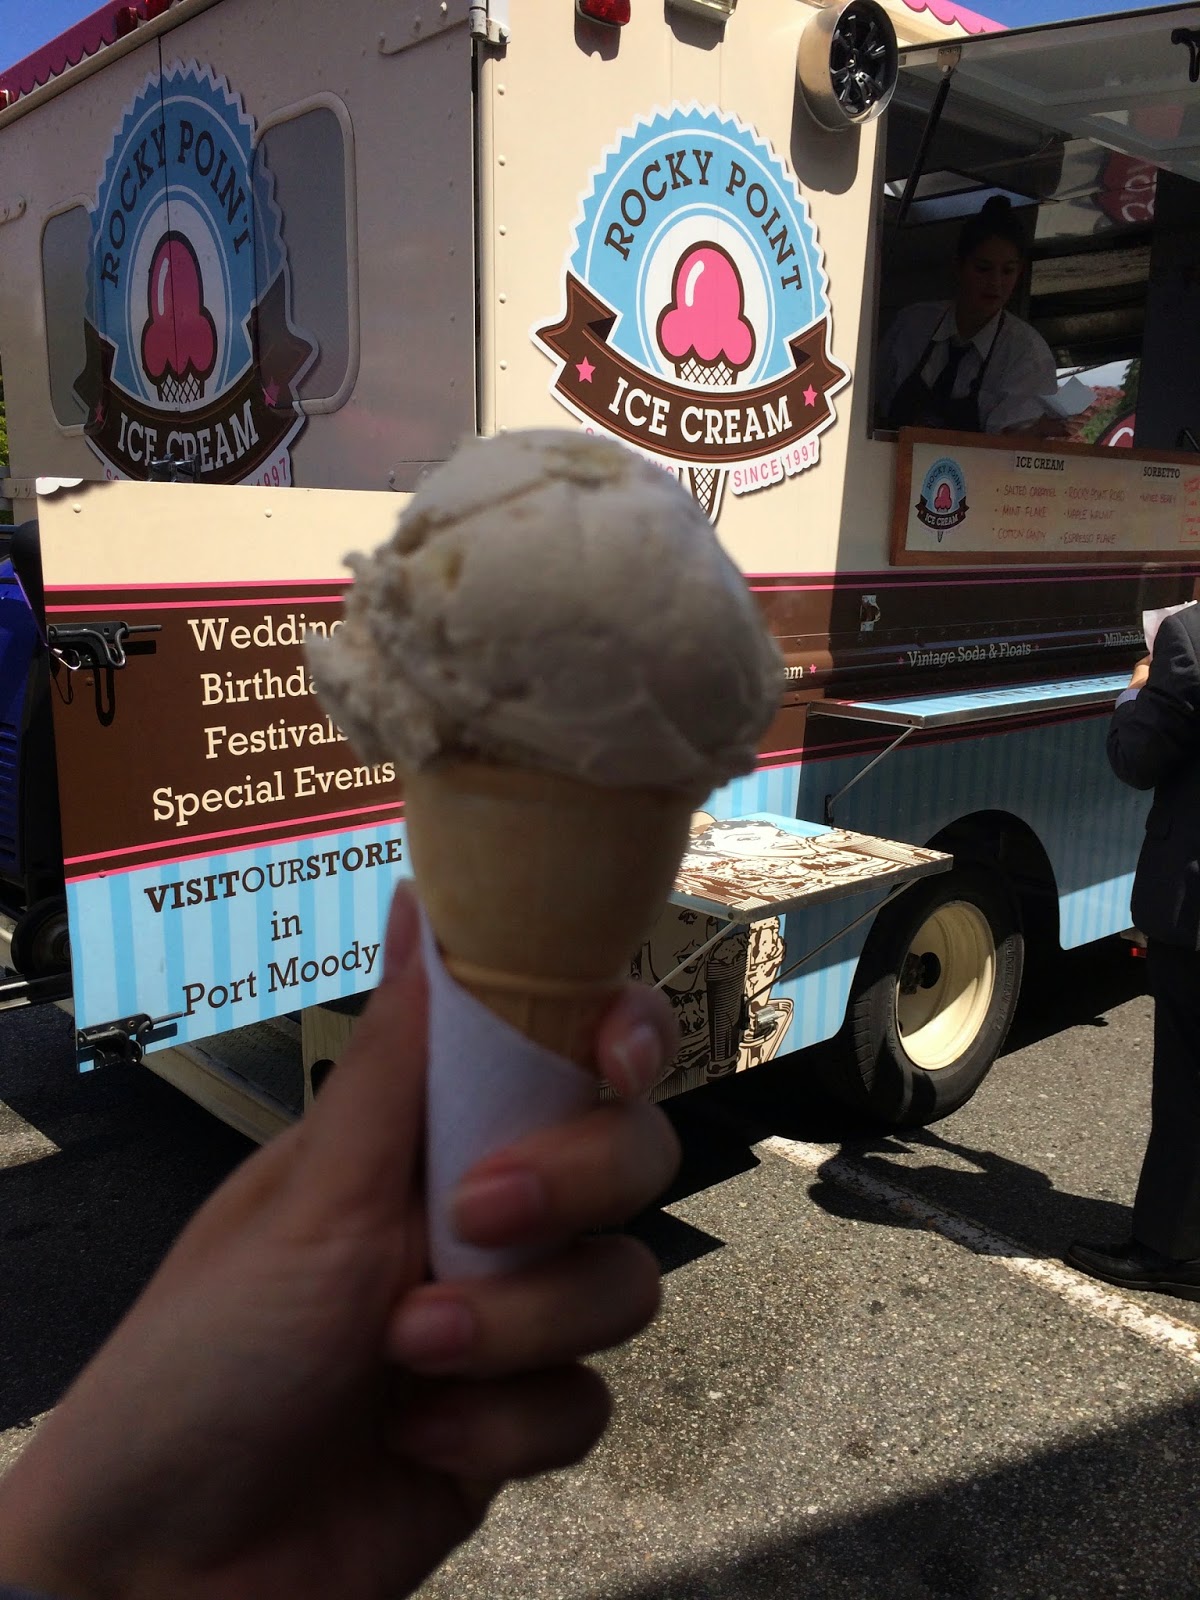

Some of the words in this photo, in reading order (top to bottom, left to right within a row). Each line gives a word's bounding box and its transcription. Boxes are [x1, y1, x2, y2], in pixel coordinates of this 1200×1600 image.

[101, 122, 166, 288] ROCKY
[178, 120, 252, 255] POINT
[603, 149, 714, 262] ROCKY
[725, 161, 804, 291] POINT
[607, 376, 671, 438] ICE
[680, 395, 793, 445] CREAM
[117, 411, 158, 468] ICE
[733, 458, 782, 488] SINCE
[785, 440, 818, 470] 1997
[926, 464, 947, 490] ROCKY
[947, 466, 963, 491] POINT
[1015, 456, 1033, 468] ICE
[1033, 458, 1065, 471] CREAM
[1143, 466, 1181, 479] SORBETTO
[1004, 484, 1027, 496] SALTED
[924, 512, 936, 525] ICE
[936, 513, 959, 527] CREAM
[1002, 505, 1022, 517] MINT
[1025, 506, 1048, 518] FLAKE
[907, 650, 956, 668] Vintage
[957, 645, 987, 663] Soda
[988, 642, 998, 658] &
[999, 641, 1032, 658] Floats
[1104, 630, 1146, 648] Milkshak
[200, 665, 319, 706] Birthd
[204, 714, 350, 760] Festivals
[152, 771, 286, 827] Special
[294, 760, 397, 800] Events
[270, 911, 303, 942] in
[182, 971, 258, 1018] Port
[267, 941, 381, 993] Moody
